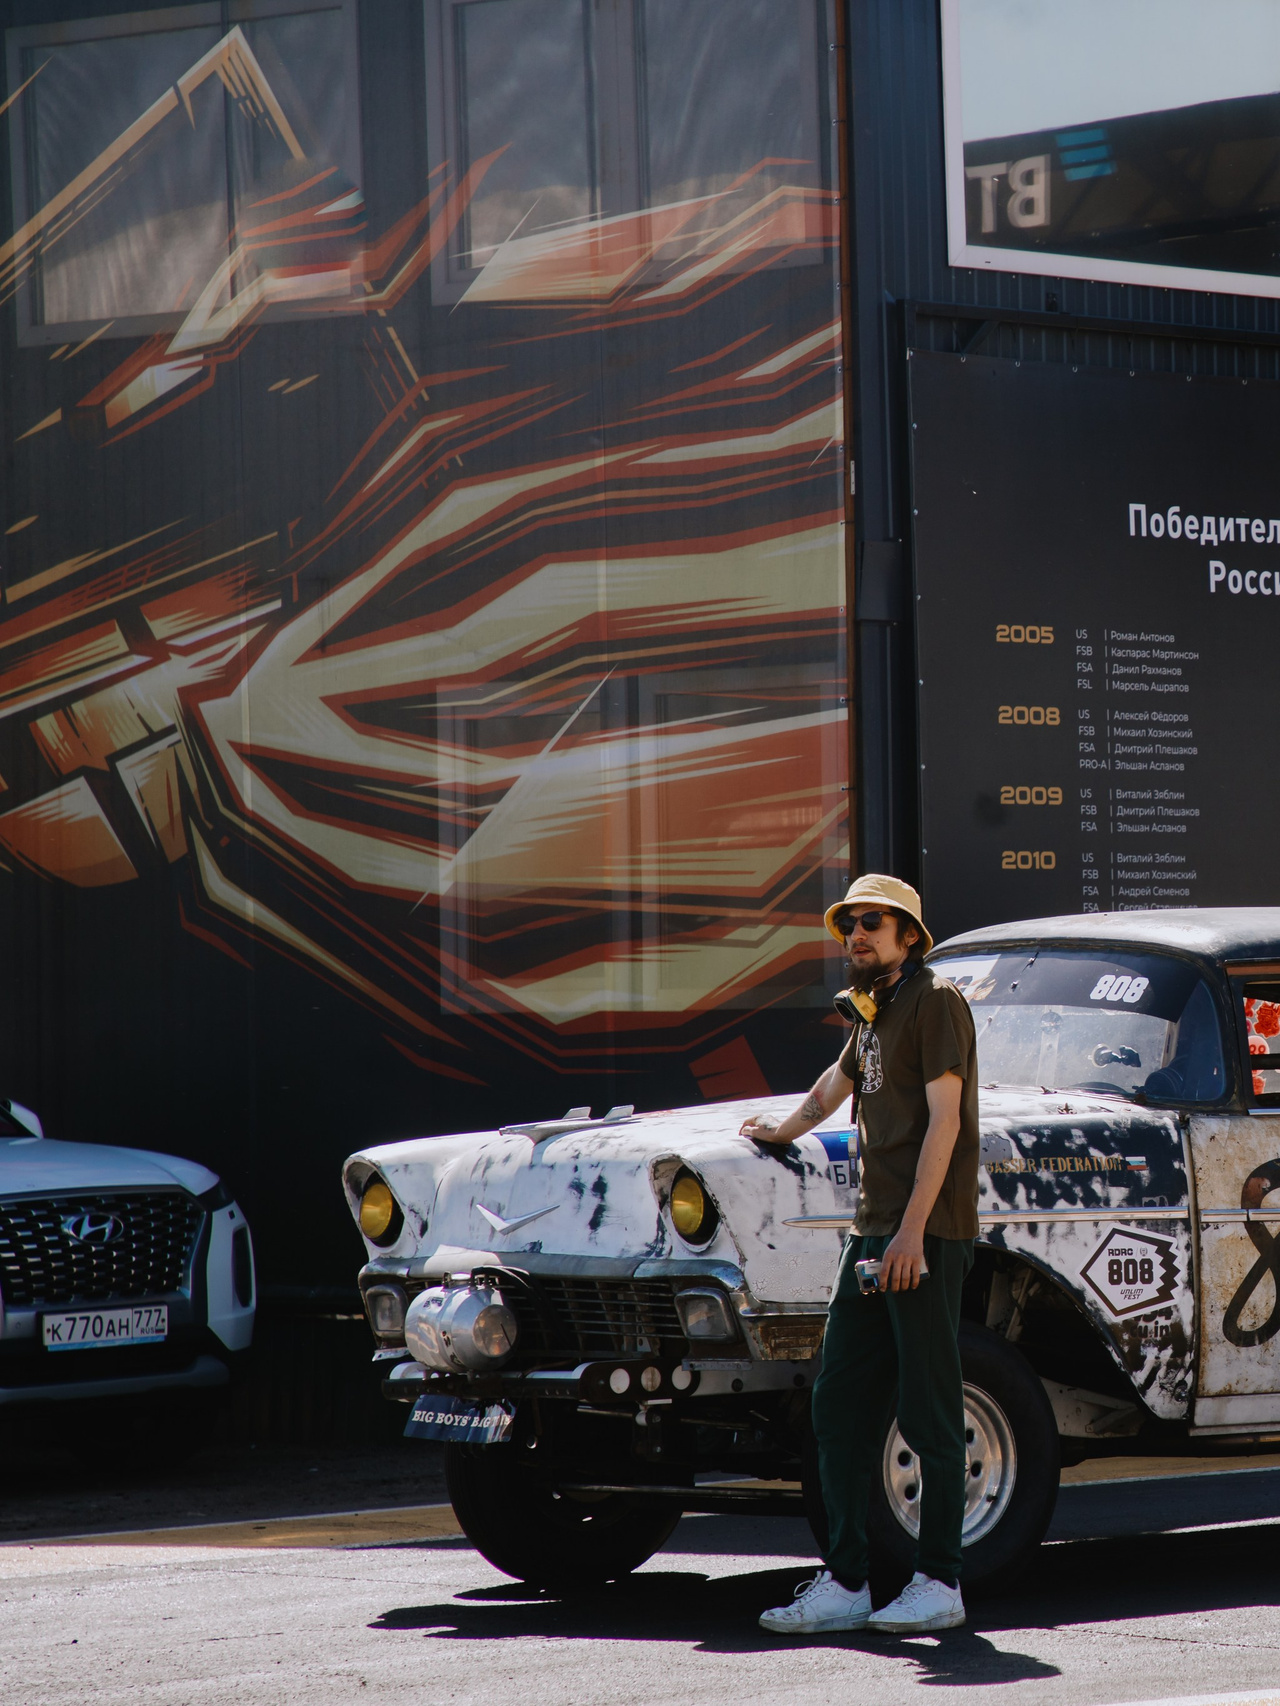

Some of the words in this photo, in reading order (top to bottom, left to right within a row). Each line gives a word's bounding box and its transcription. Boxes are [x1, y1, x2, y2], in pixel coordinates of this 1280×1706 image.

[996, 625, 1054, 643] 2005
[1076, 629, 1087, 639] US
[1110, 631, 1138, 641] Роман
[1140, 632, 1175, 642] Антонов
[1077, 646, 1092, 656] FSB
[1111, 648, 1150, 659] Каспарас
[1152, 649, 1199, 660] Мартинсон
[1077, 662, 1093, 672] FSA
[1112, 664, 1139, 674] Данил
[1141, 665, 1182, 675] Рахманов
[1078, 679, 1092, 689] FSL
[1112, 681, 1149, 692] Марсель
[1150, 682, 1189, 693] Ашрапов
[999, 706, 1060, 725] 2008
[1078, 709, 1090, 719] US
[1113, 711, 1149, 720] Алексей
[1151, 712, 1189, 723] Фёдоров
[1079, 726, 1095, 736] FSB
[1113, 727, 1146, 737] Михаил
[1147, 728, 1192, 738] Хозинский
[1079, 742, 1095, 752] FSA
[1114, 744, 1154, 755] Дмитрий
[1155, 744, 1198, 755] Плешаков
[1080, 759, 1107, 769] PRO-A
[1115, 760, 1147, 770] Эльшан
[1149, 761, 1185, 771] Асланов
[1001, 786, 1062, 805] 2009
[1080, 789, 1092, 798] US
[1116, 789, 1152, 799] Виталий
[1154, 789, 1185, 799] Зяблин
[1081, 805, 1097, 815] FSB
[1116, 806, 1156, 817] Дмитрий
[1157, 806, 1200, 816] Плешаков
[1081, 822, 1097, 831] FSA
[1117, 822, 1149, 832] Эльшан
[1151, 823, 1186, 832] Асланов
[1002, 851, 1055, 869] 2010
[1082, 853, 1094, 862] US
[1117, 853, 1153, 862] Виталий
[1155, 853, 1186, 863] Зяблин
[1083, 869, 1098, 879] FSB
[1118, 870, 1150, 879] Михаил
[1151, 870, 1197, 879] Хозинский
[1083, 886, 1099, 895] FSA
[1118, 887, 1150, 897] Андрей
[1152, 886, 1190, 896] Семенов
[1083, 903, 1099, 912] FSA
[1089, 974, 1150, 1004] 808
[1040, 1155, 1122, 1173] FEDERATION
[1107, 1248, 1134, 1256] RDRC
[1108, 1258, 1154, 1286] 808
[134, 1308, 163, 1328] 777
[140, 1327, 155, 1335] RUS
[412, 1410, 434, 1423] BIG
[435, 1412, 472, 1427] BOYS'
